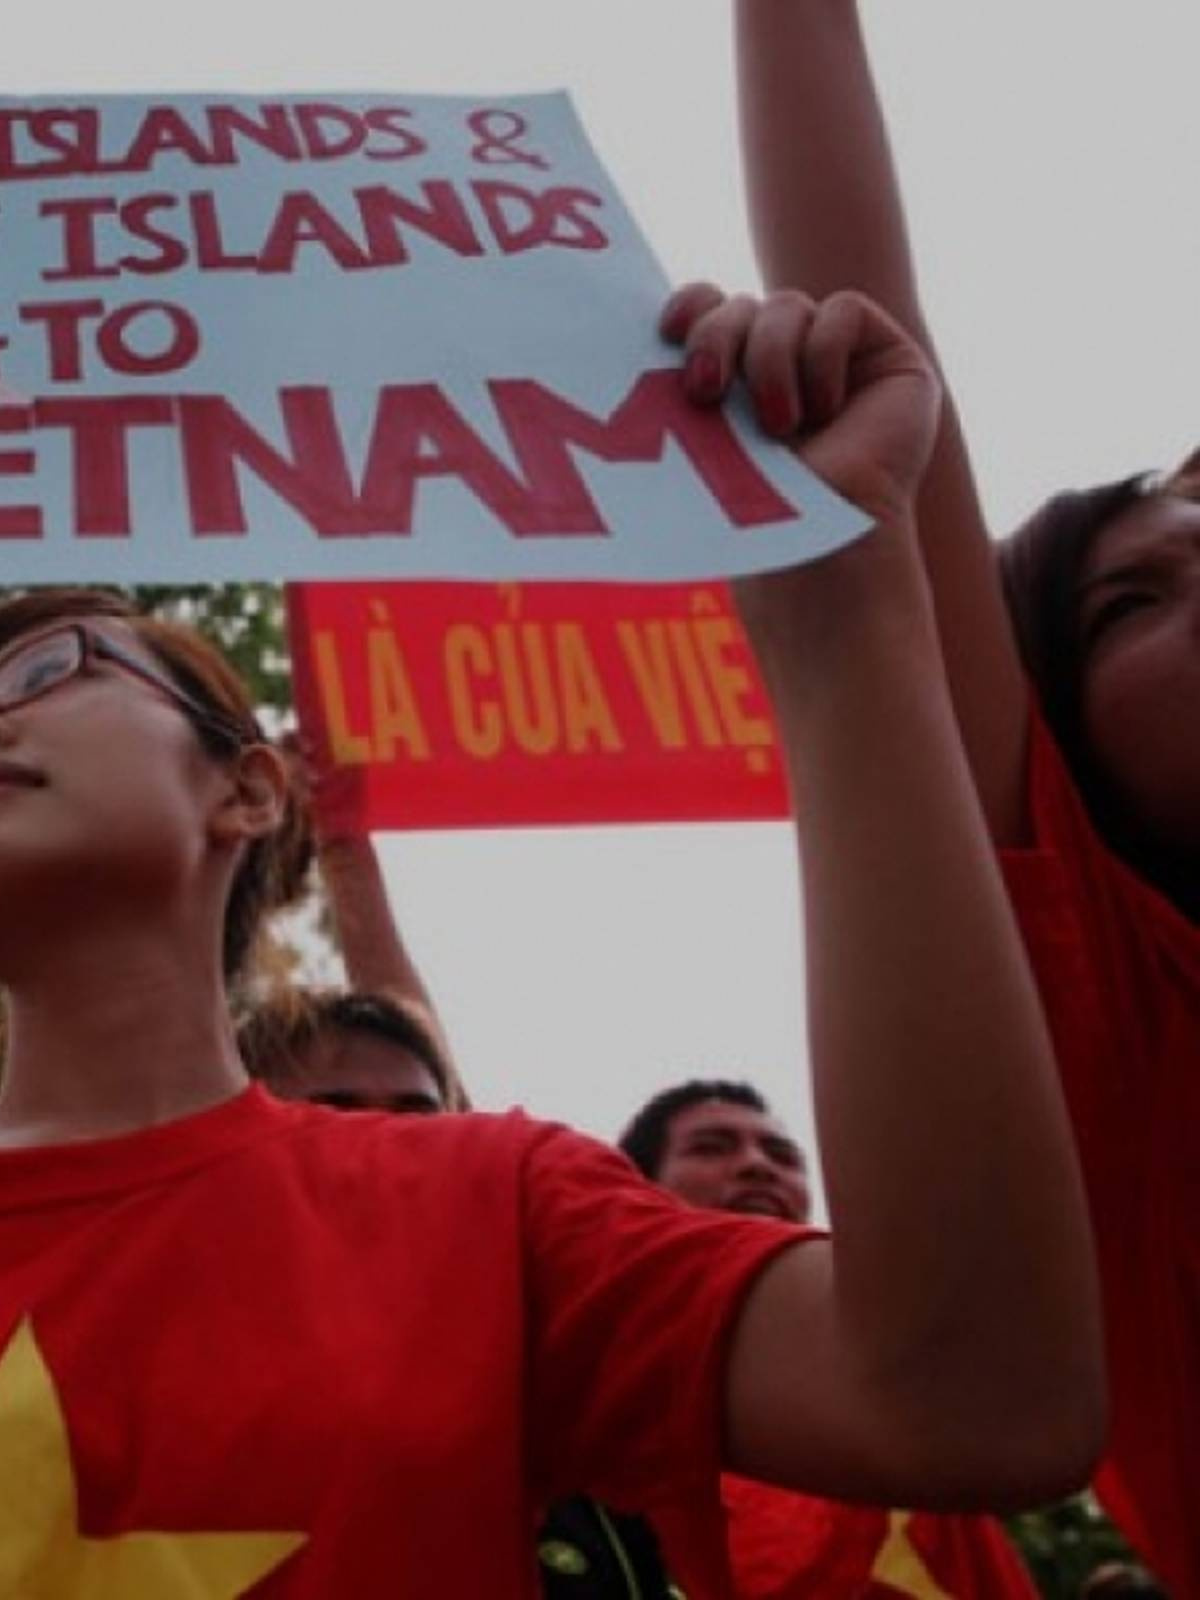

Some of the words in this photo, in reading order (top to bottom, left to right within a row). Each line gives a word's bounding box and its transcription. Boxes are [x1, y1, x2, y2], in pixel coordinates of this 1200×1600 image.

[467, 108, 551, 170] &
[39, 179, 609, 281] ISLANDS
[19, 299, 200, 382] TO
[311, 598, 432, 766] LÀ
